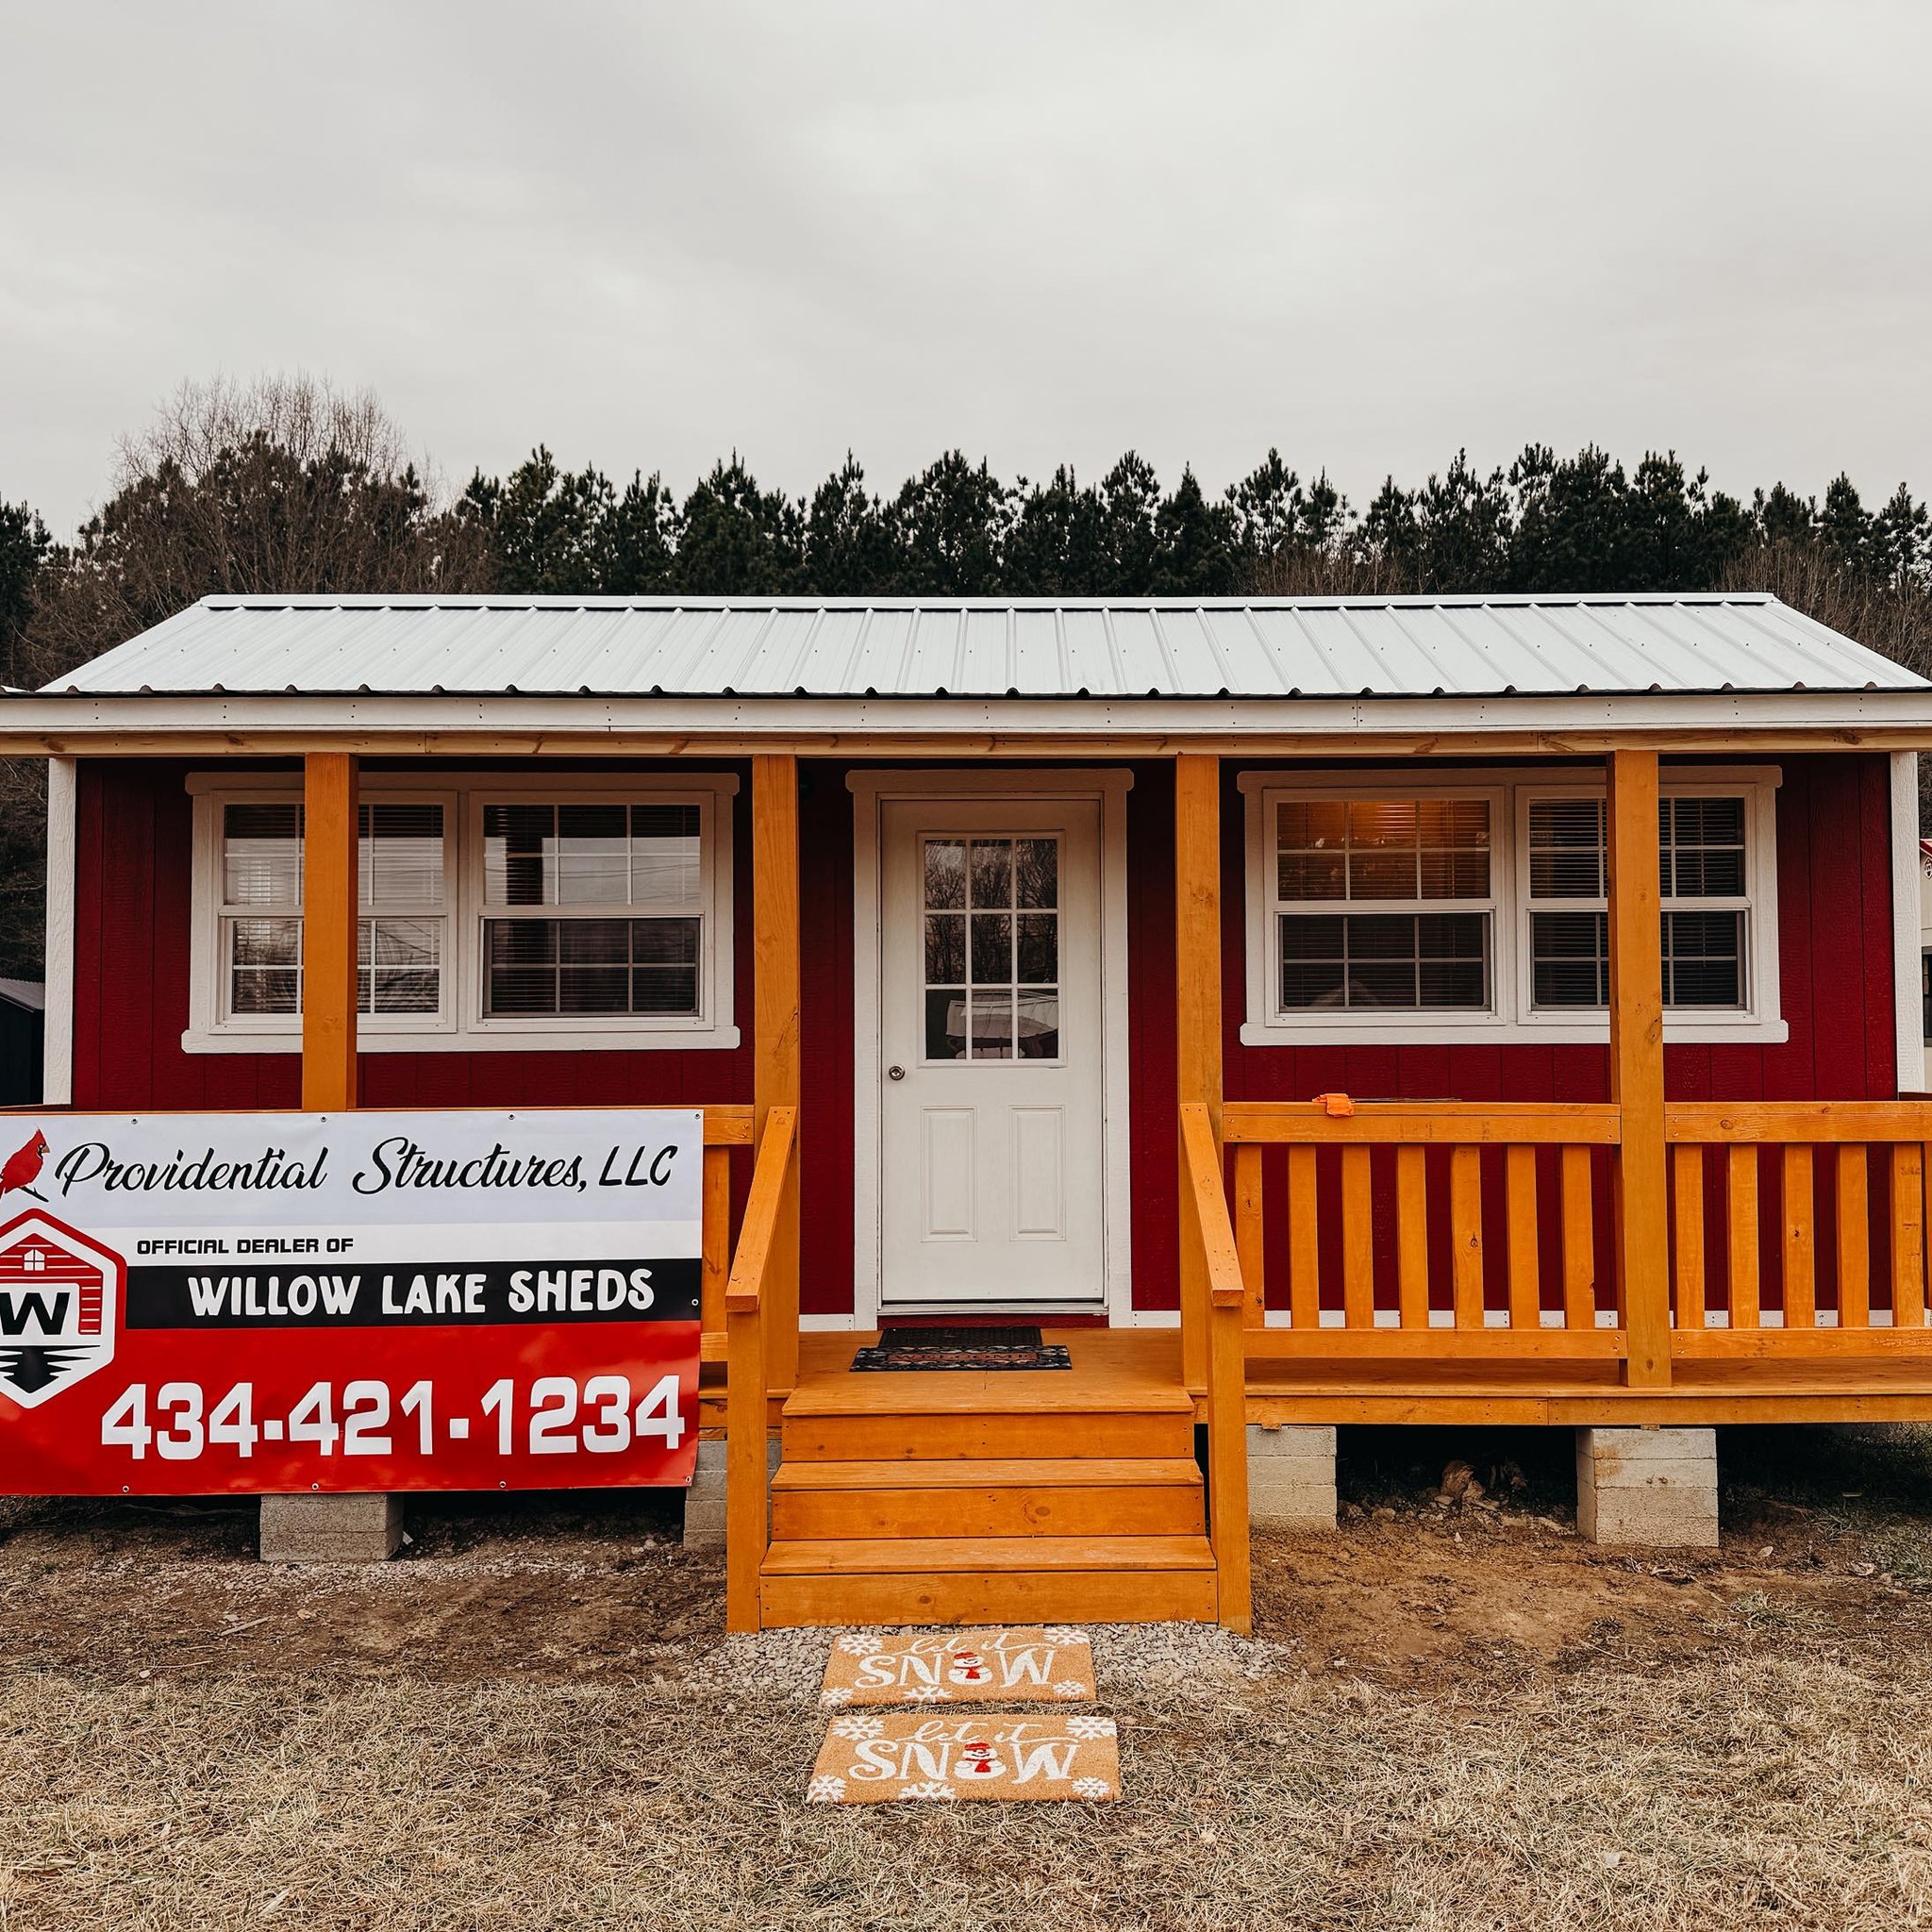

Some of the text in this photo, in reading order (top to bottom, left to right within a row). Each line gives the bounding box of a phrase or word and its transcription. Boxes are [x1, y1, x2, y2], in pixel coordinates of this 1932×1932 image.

[55, 1137, 679, 1199] Providential Structures, LLC
[137, 1238, 355, 1256] OFFICIAL DEALER OF
[188, 1269, 656, 1318] WILLOW LAKE SHEDS
